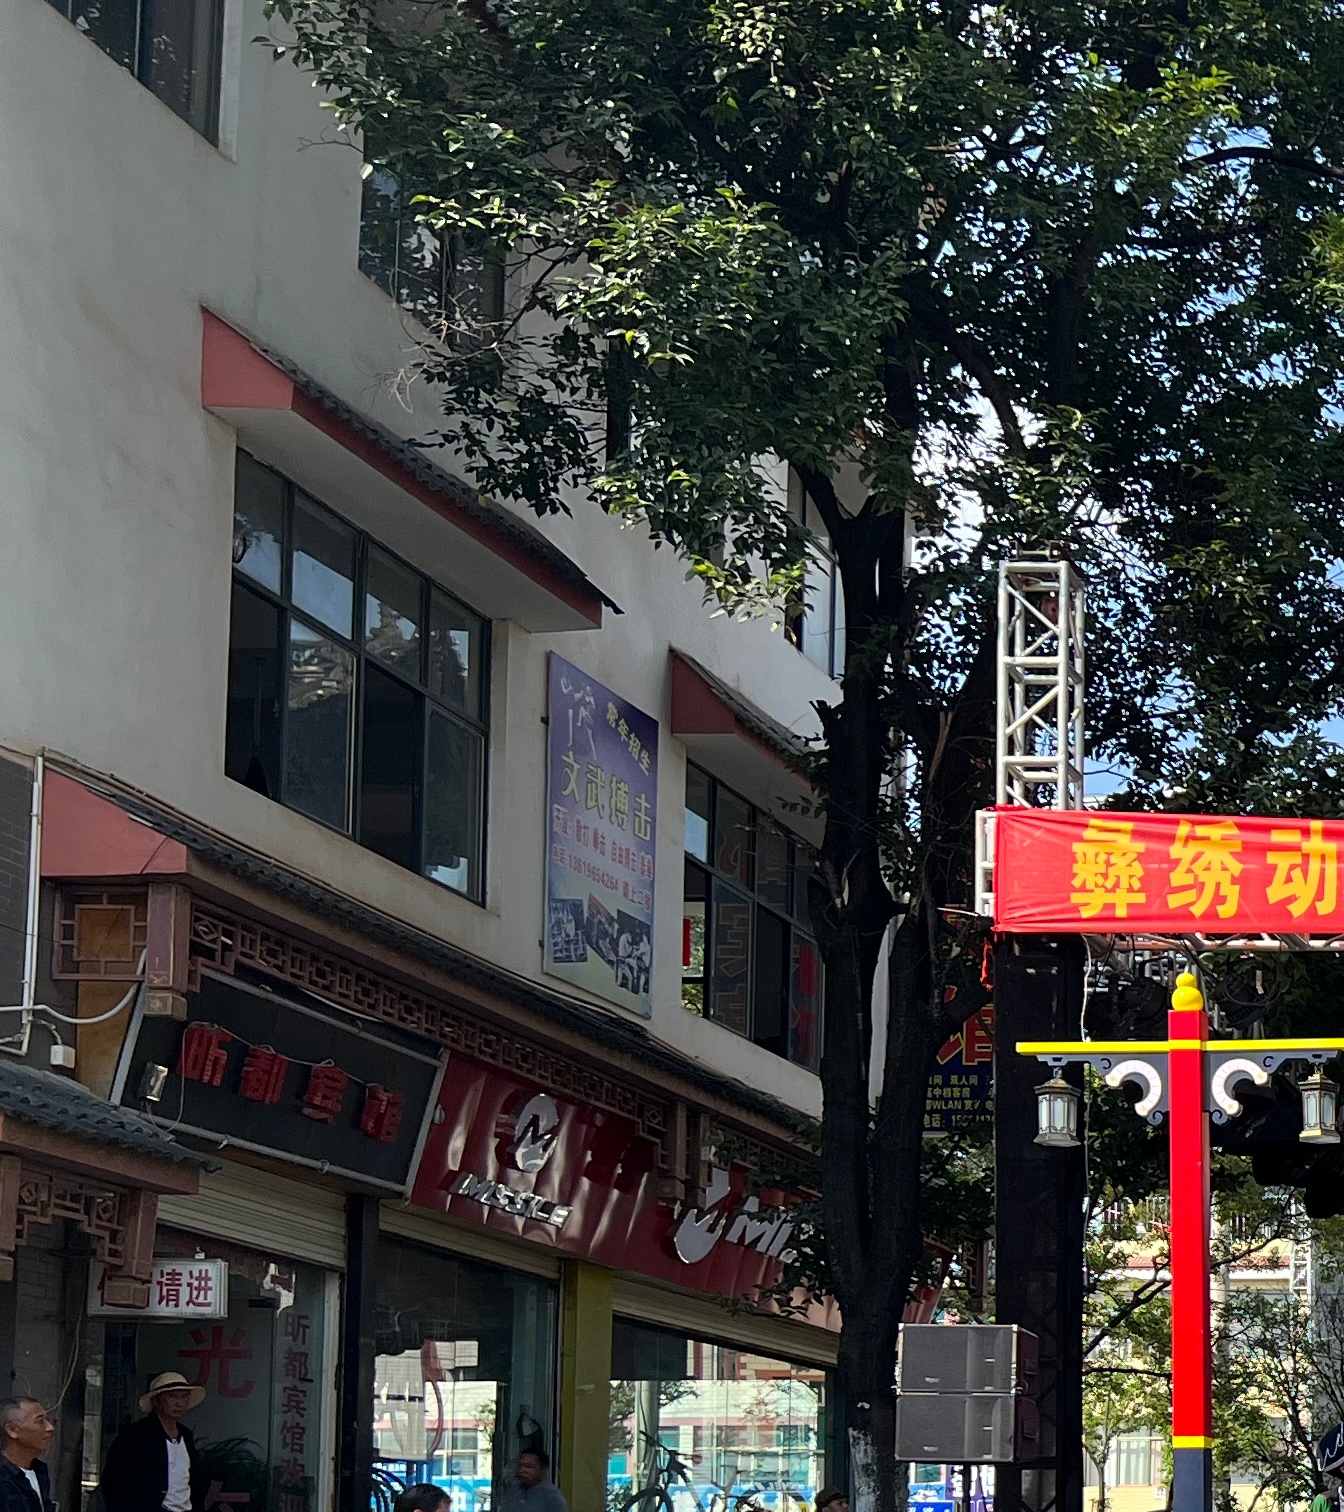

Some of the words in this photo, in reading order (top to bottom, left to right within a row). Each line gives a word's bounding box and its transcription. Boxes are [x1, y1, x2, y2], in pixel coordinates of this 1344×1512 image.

[561, 750, 651, 842] 文武搏击
[457, 1173, 573, 1230] MISSILE
